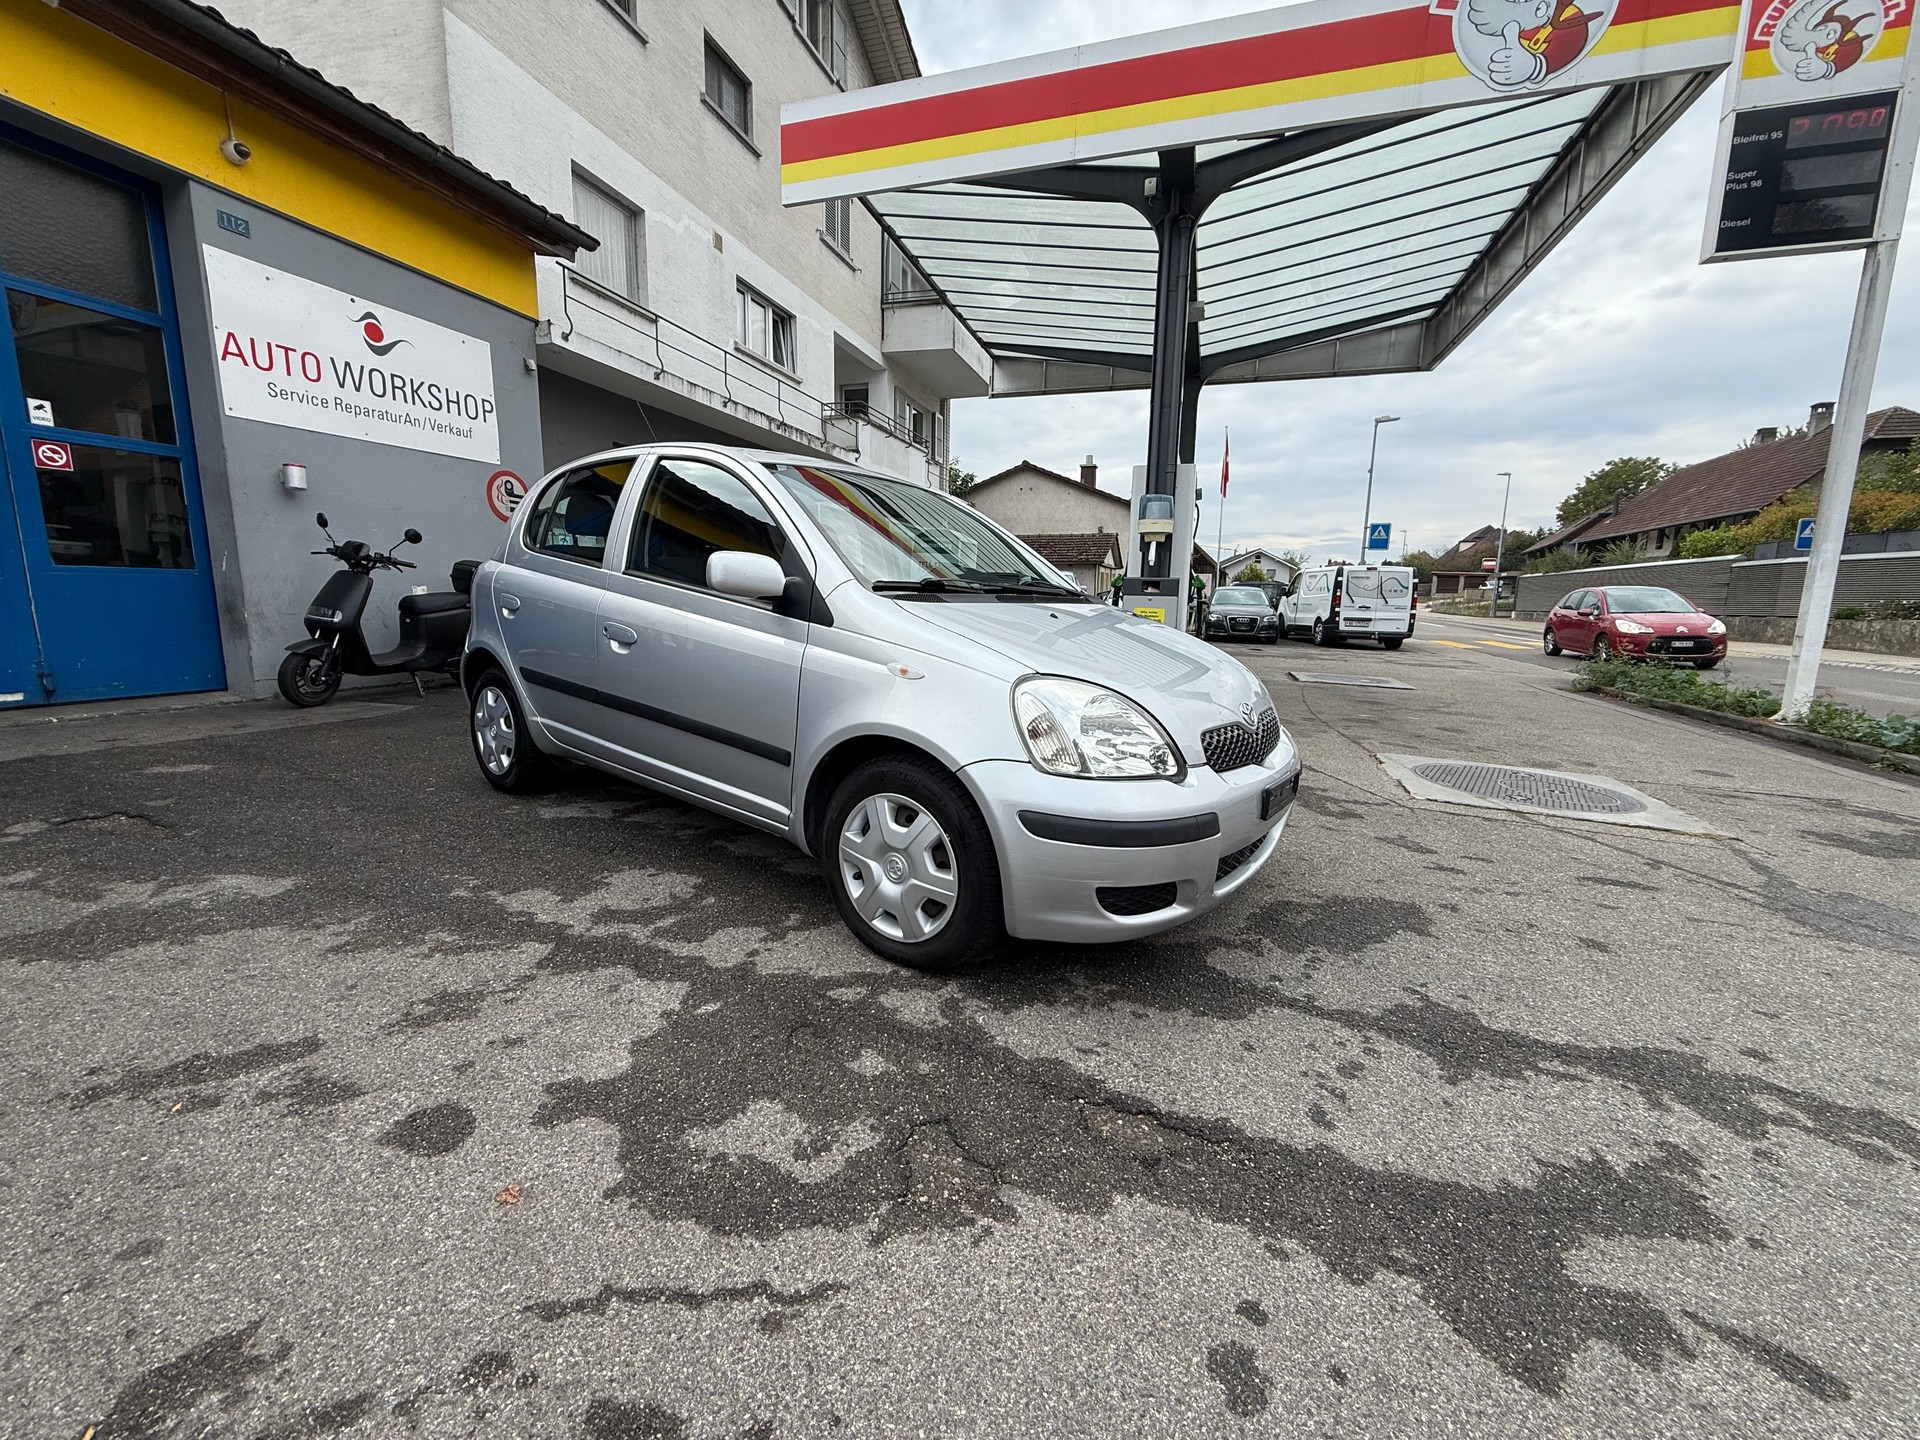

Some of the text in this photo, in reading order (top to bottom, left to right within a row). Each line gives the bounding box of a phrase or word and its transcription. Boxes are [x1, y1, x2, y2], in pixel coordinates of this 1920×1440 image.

[1733, 130, 1784, 145] Bleifrei 95
[1727, 169, 1758, 181] Super
[1725, 179, 1763, 191] Plus 98
[221, 213, 247, 234] 112
[1720, 217, 1752, 229] Diesel
[220, 331, 494, 423] AUTO WORKSHOP
[267, 381, 329, 409] Service
[32, 415, 52, 423] VIDEO
